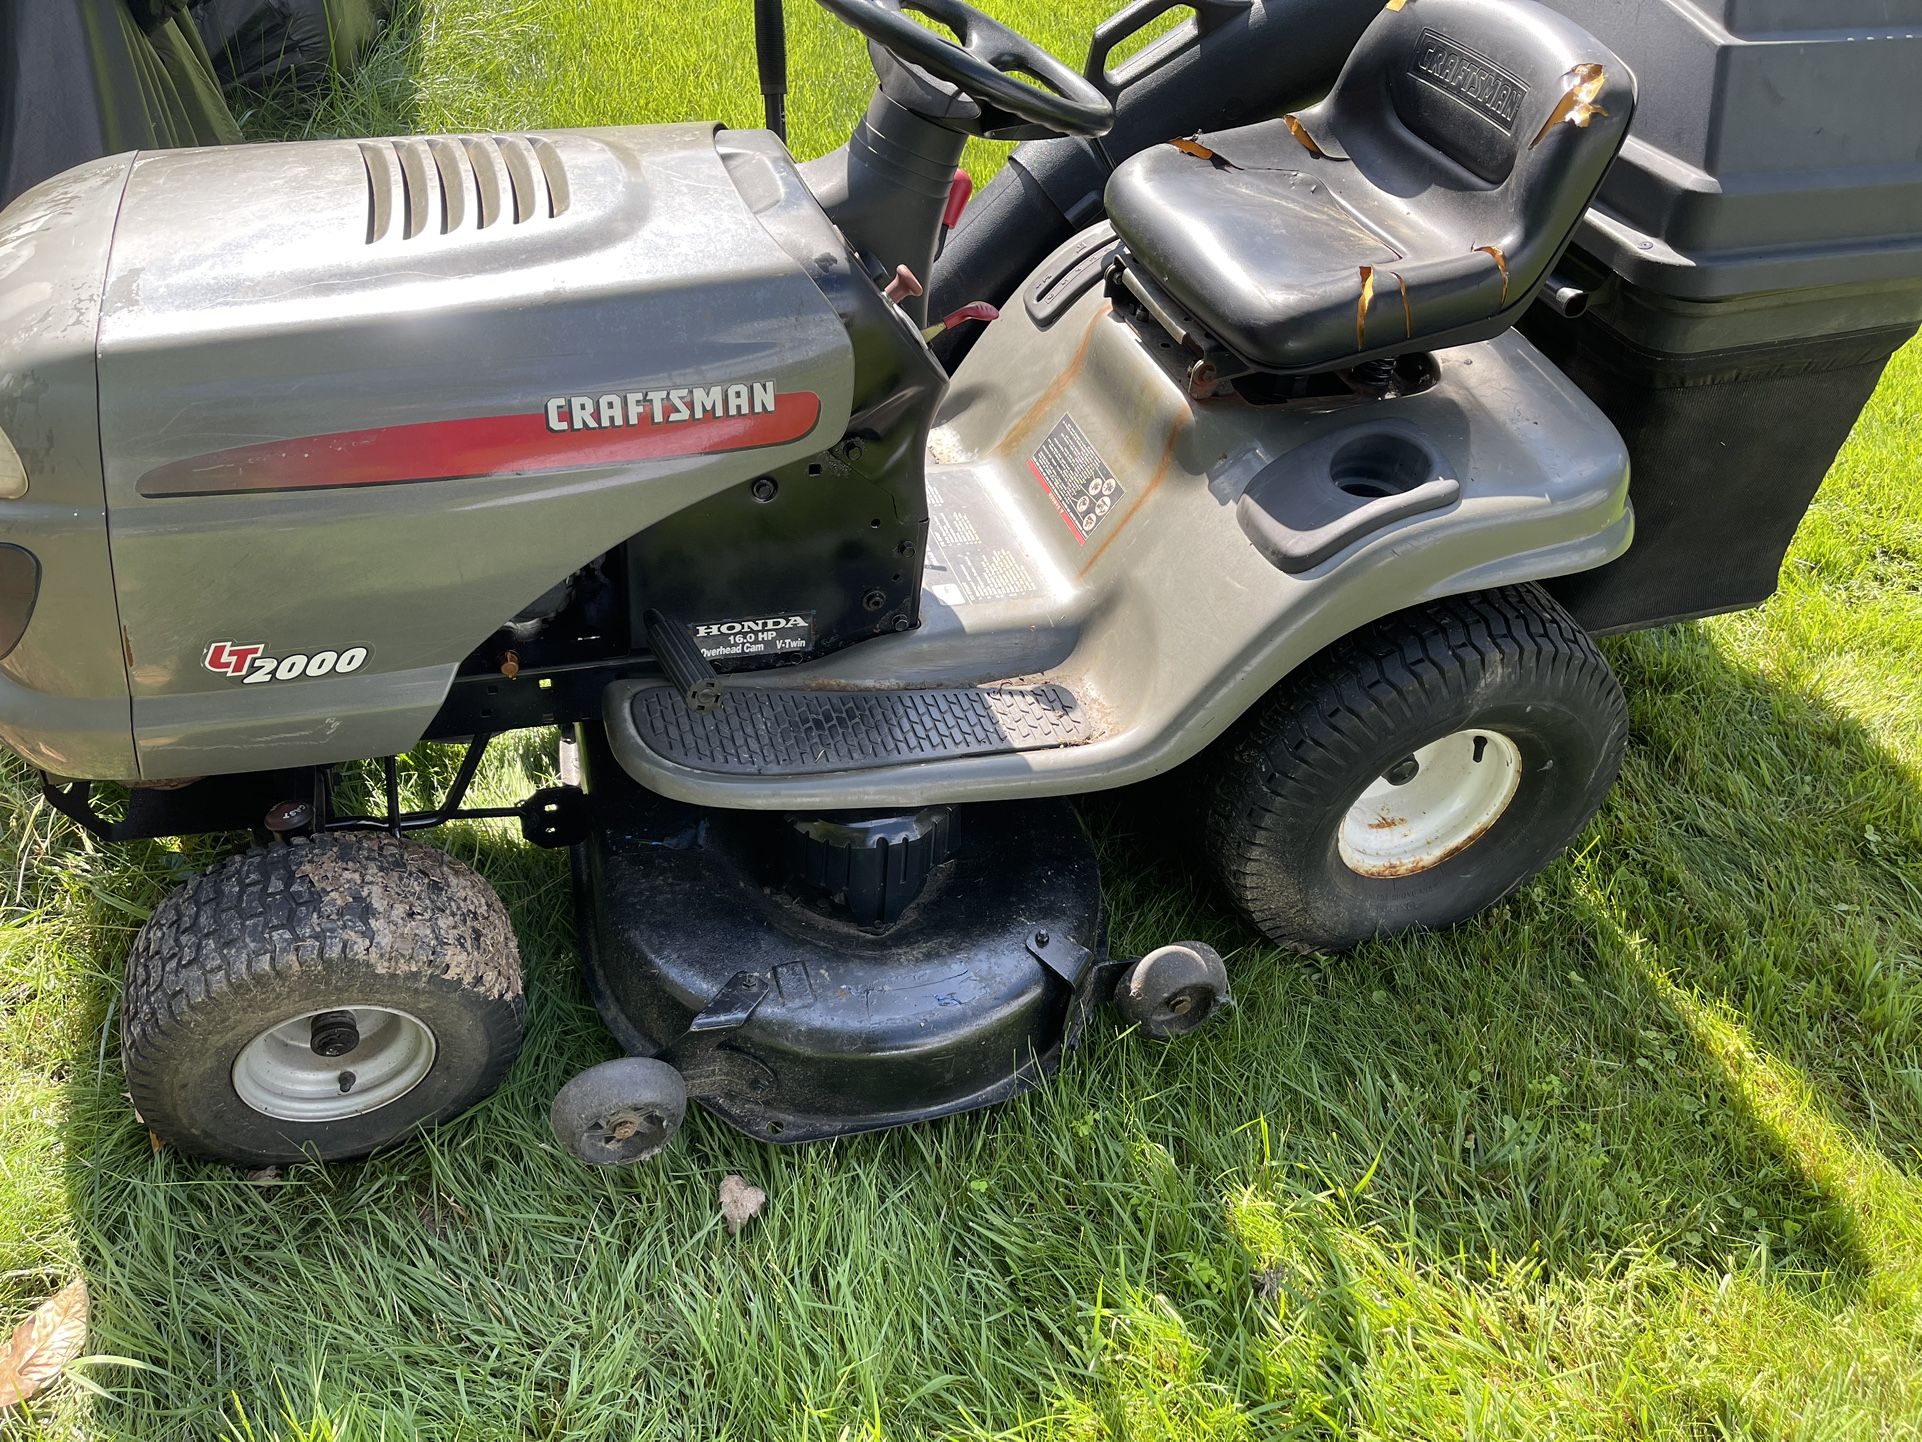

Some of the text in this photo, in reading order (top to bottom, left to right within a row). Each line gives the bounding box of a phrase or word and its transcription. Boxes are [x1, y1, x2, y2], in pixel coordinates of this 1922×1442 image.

[1418, 41, 1521, 121] CRAFTSMAN
[546, 380, 775, 432] CRAFTSMAN
[696, 616, 808, 637] HONDA
[728, 631, 777, 644] 16.0 HP
[204, 641, 368, 684] LT 2000
[701, 638, 806, 657] Overhead Cam V-Twin
